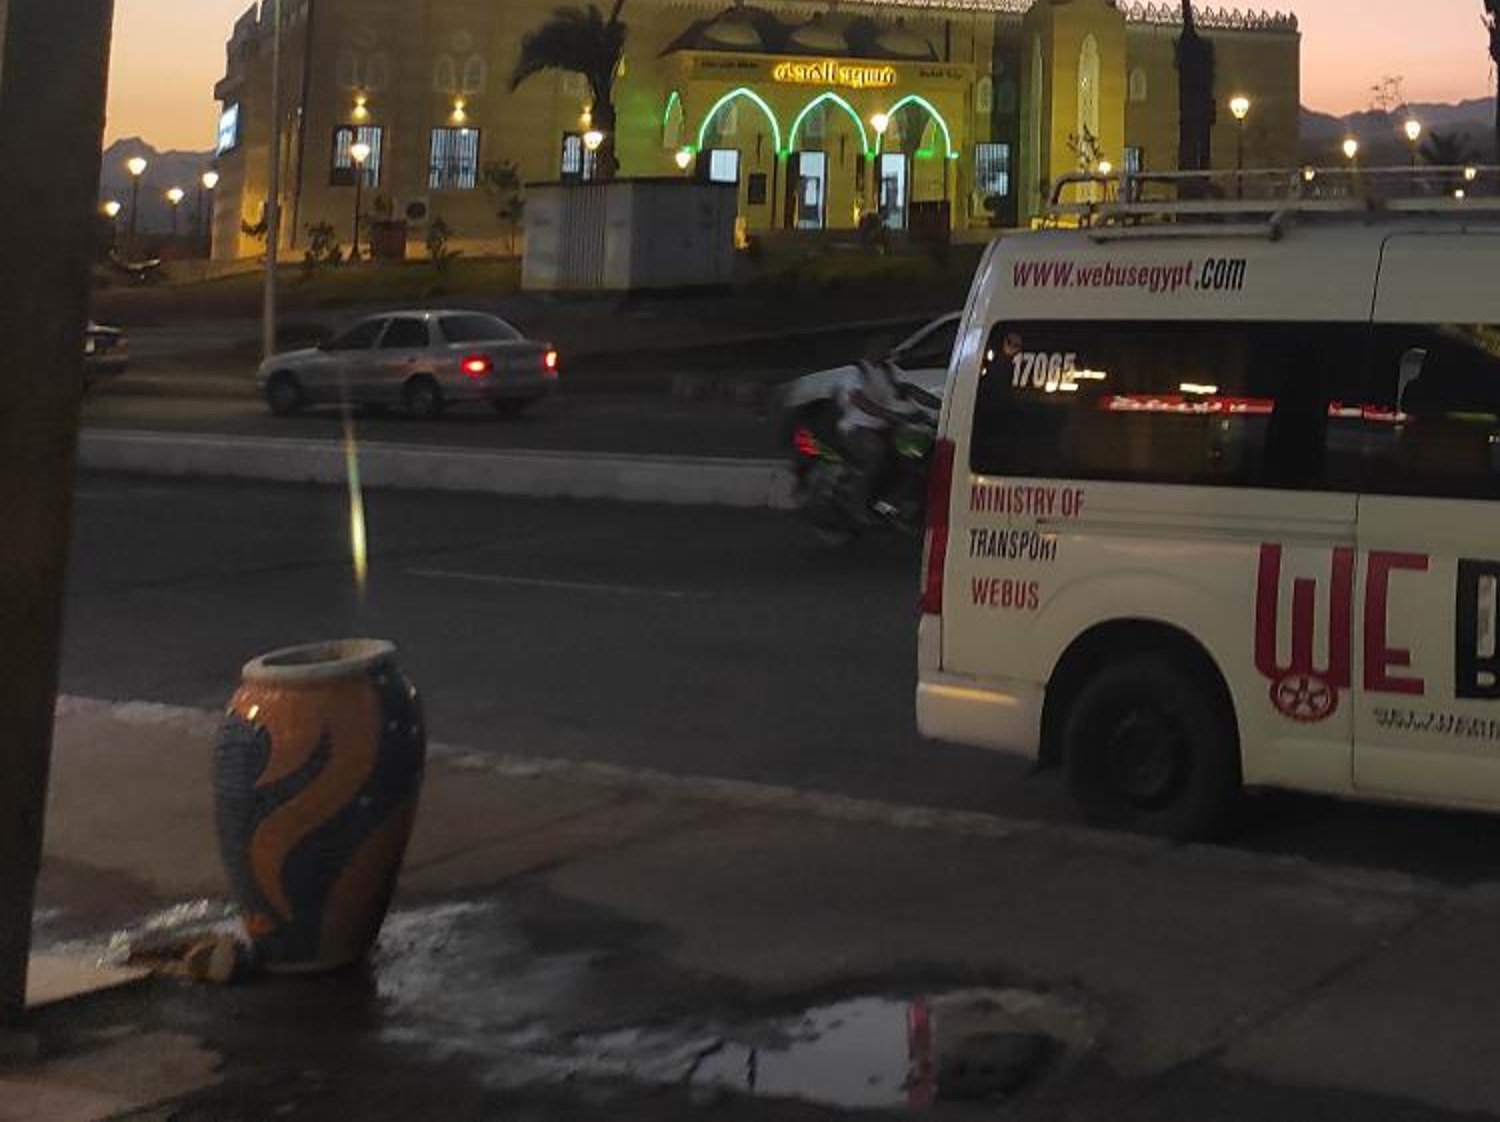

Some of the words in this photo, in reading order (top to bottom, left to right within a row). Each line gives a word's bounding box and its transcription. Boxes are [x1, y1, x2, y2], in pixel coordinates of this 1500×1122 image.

[1012, 257, 1246, 292] www.webusegypt.com
[969, 483, 1056, 515] MINISTRY
[1061, 487, 1085, 518] OF
[971, 575, 1040, 610] WEBUS
[1254, 542, 1430, 703] WE
